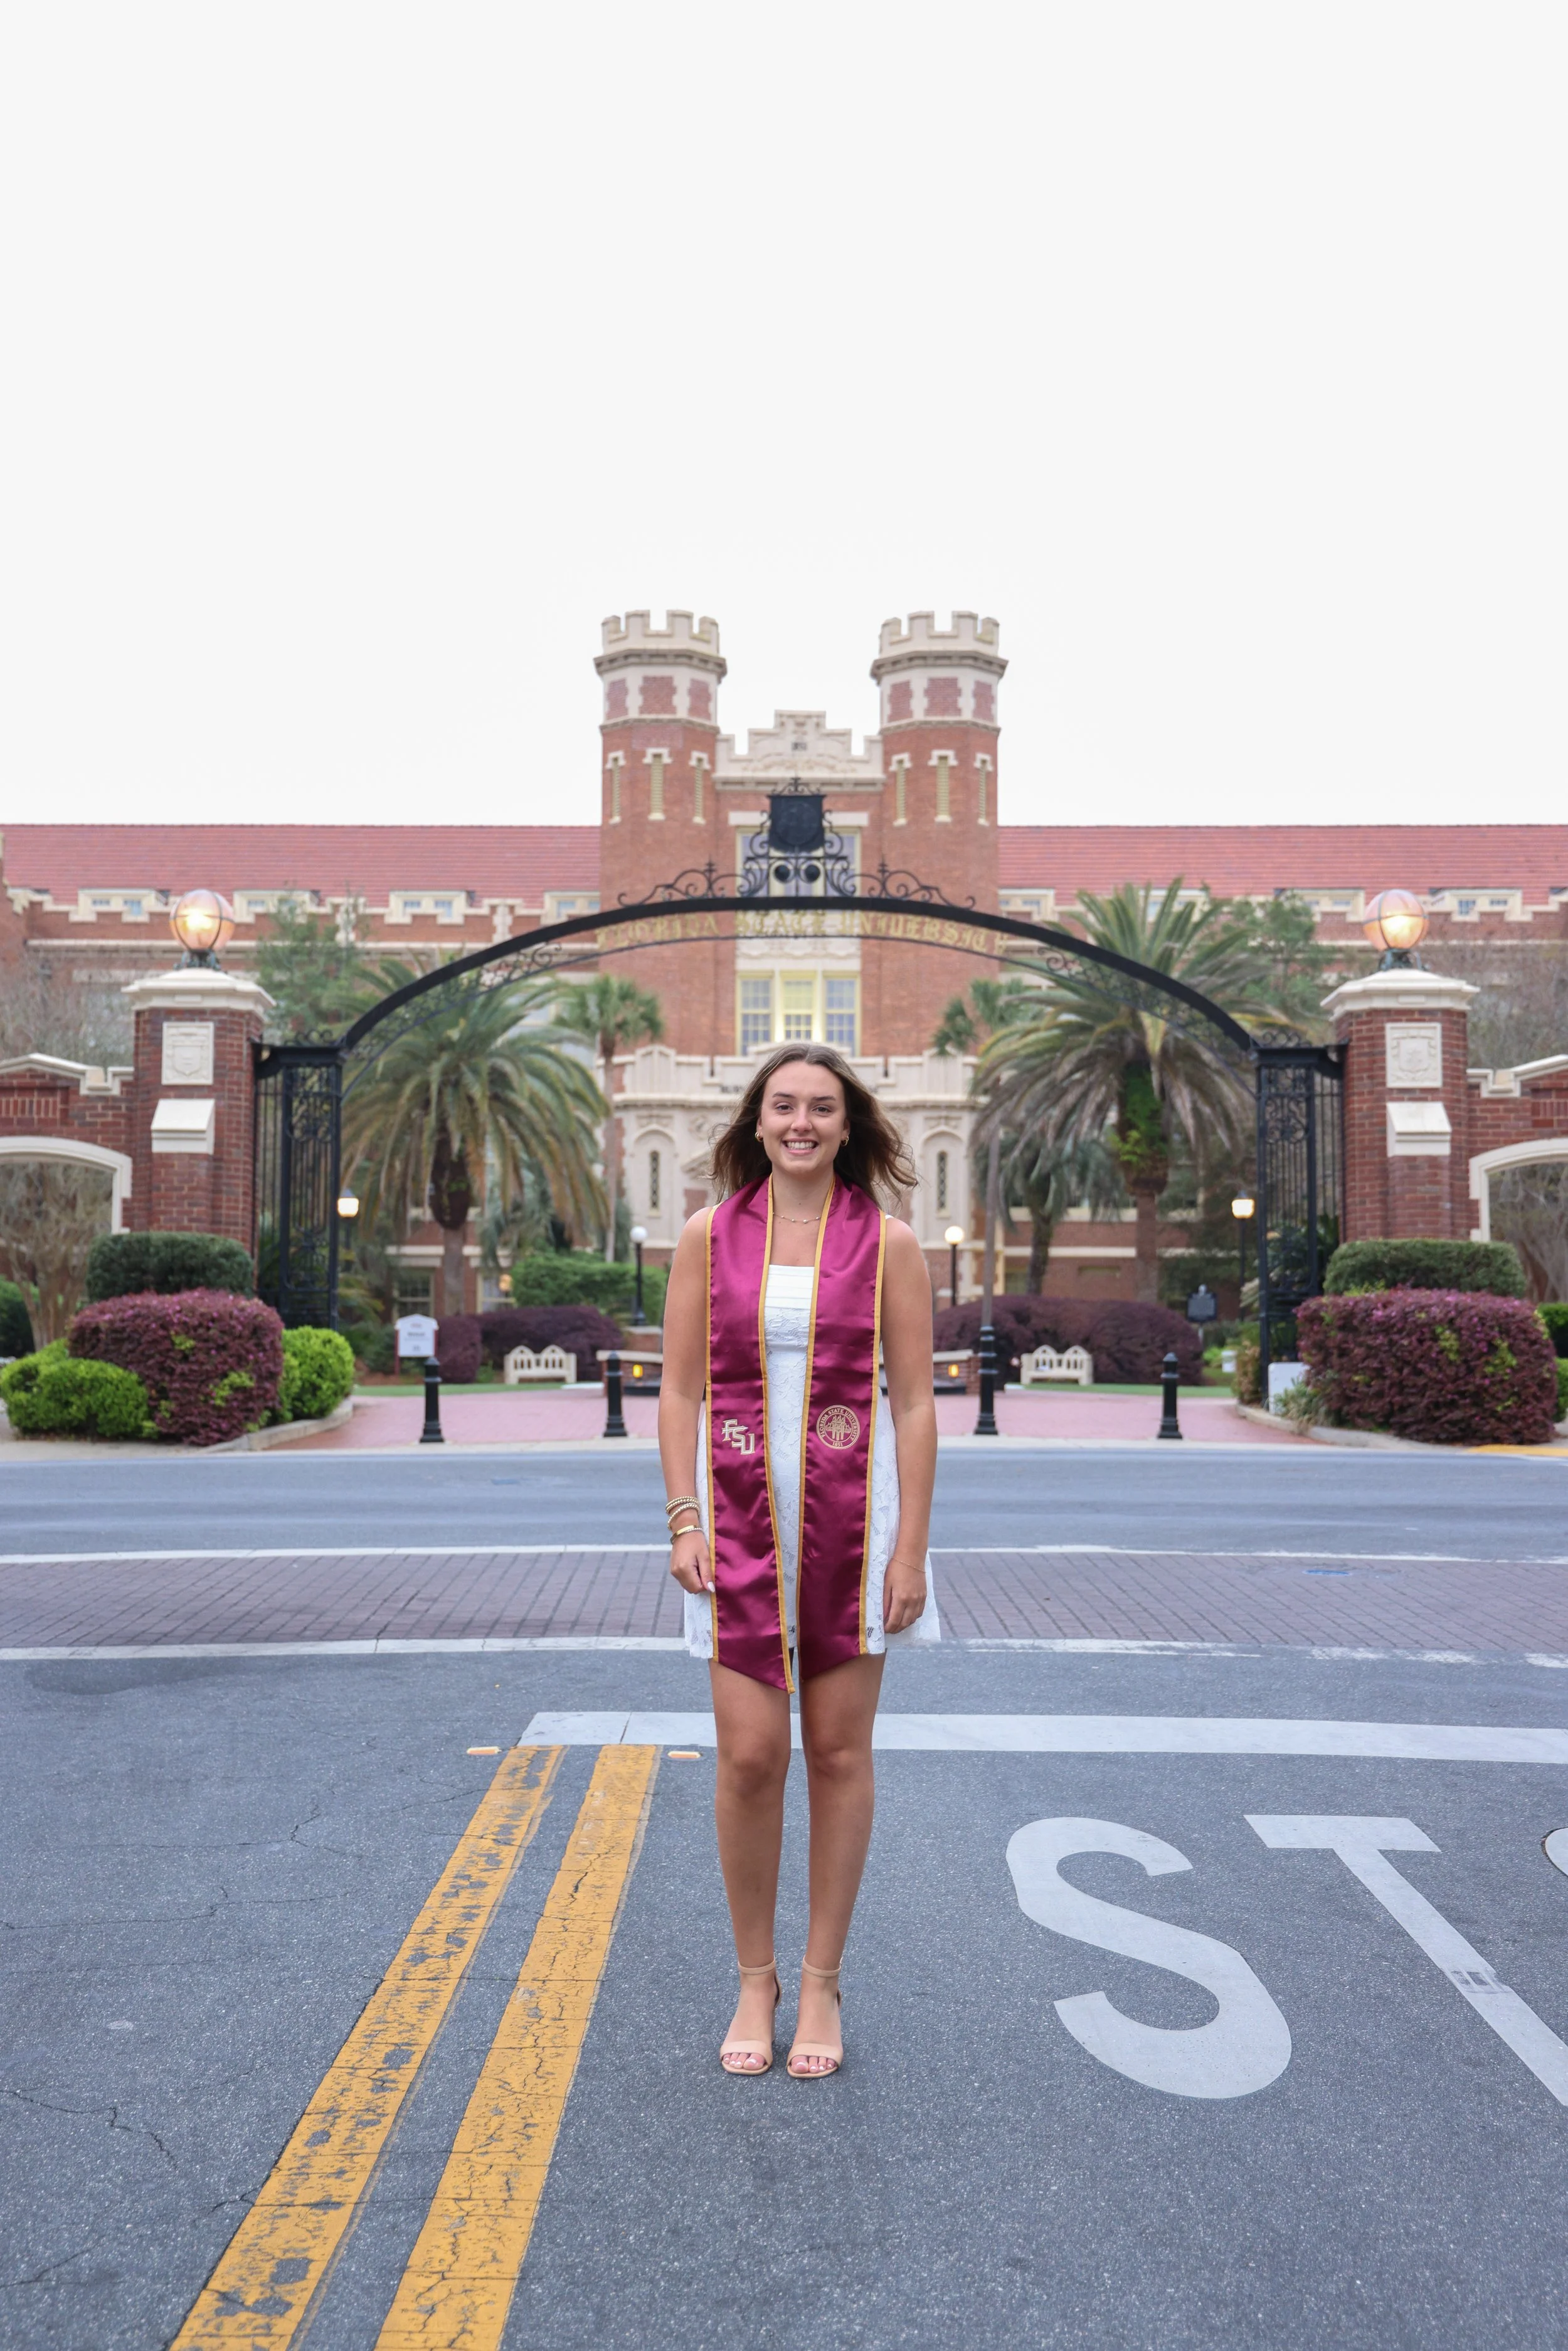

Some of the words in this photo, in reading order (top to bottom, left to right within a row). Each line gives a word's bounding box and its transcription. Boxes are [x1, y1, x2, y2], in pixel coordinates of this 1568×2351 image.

[595, 913, 721, 952] FLORIDA
[735, 910, 827, 935] STATE
[837, 910, 1009, 955] UNIVERSITY
[721, 1419, 755, 1455] FSU
[819, 1414, 829, 1438] FLORIDA
[845, 1411, 857, 1441] UNIVERSITY
[1005, 1814, 1568, 2106] ST
